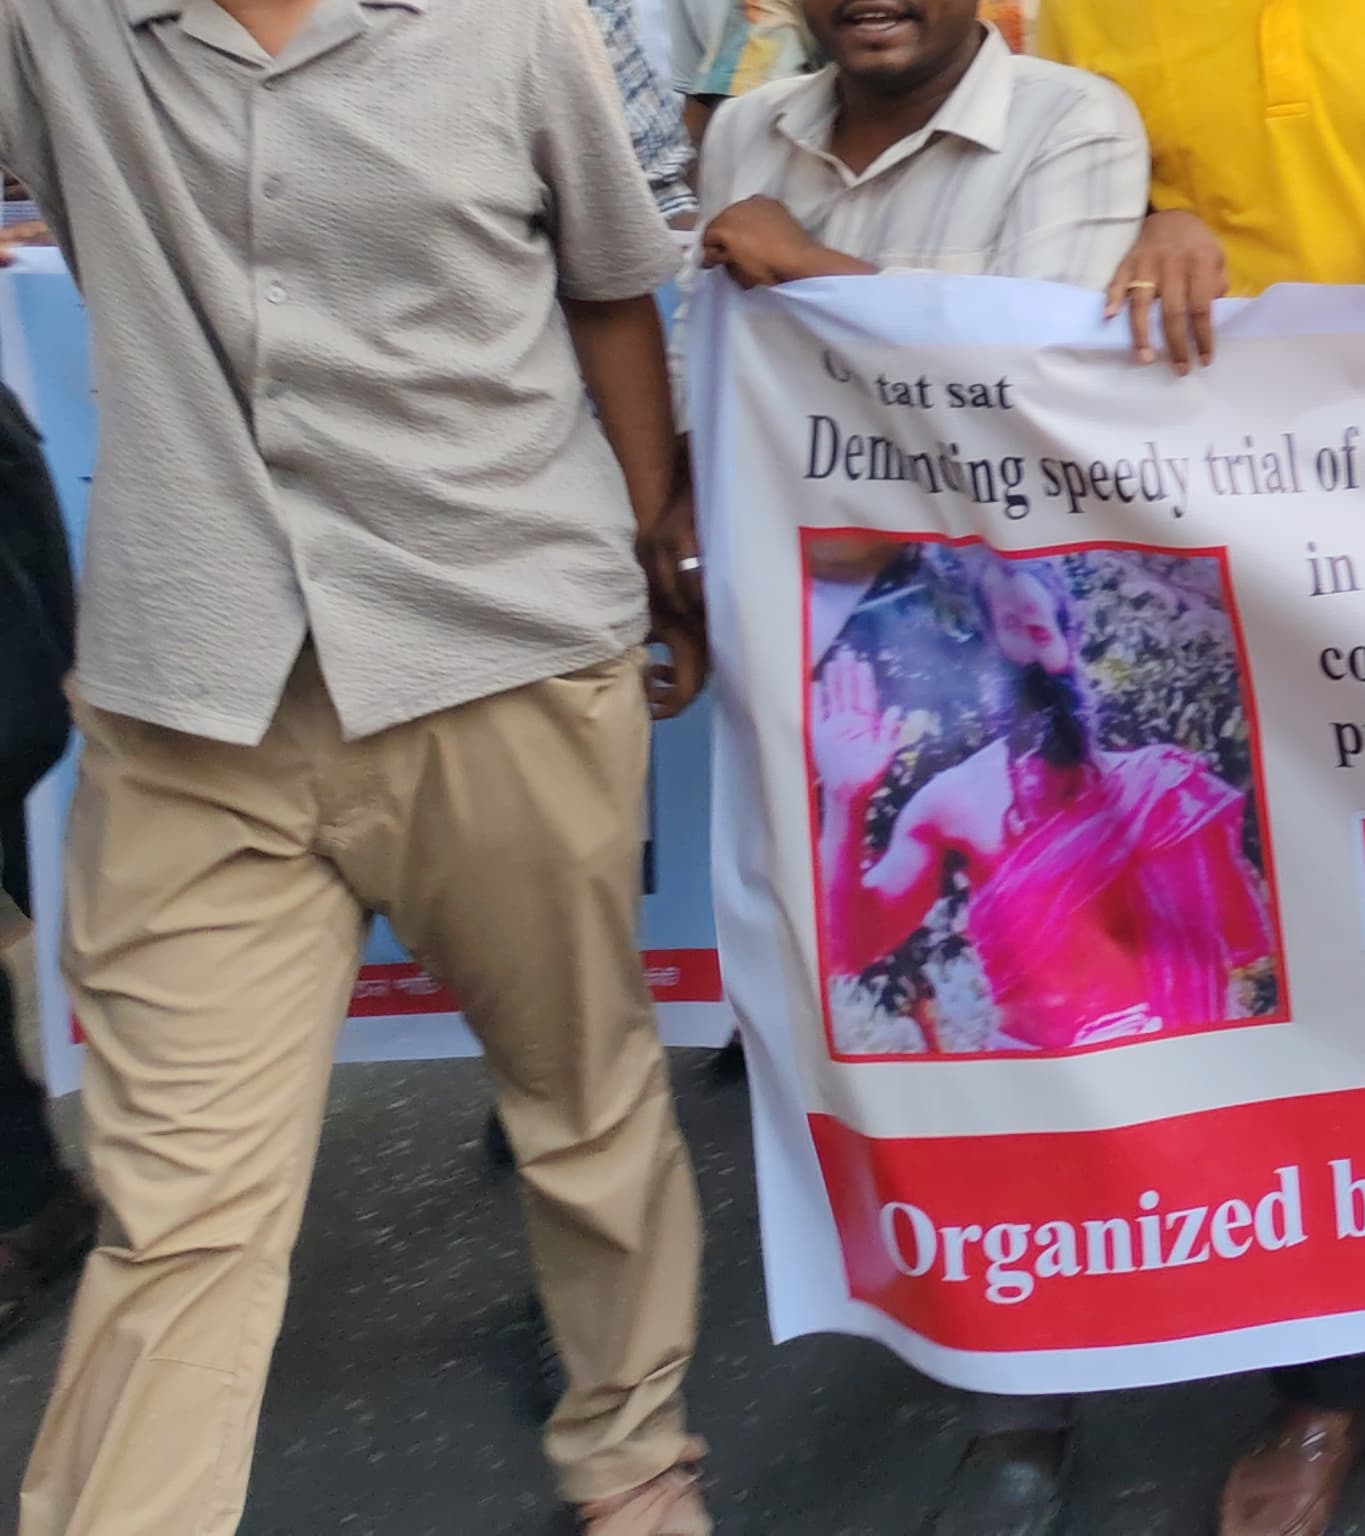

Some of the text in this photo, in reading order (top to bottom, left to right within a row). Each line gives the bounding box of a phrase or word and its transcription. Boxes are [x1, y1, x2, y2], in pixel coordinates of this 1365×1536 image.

[874, 374, 935, 409] tat
[946, 376, 1013, 409] sat
[1042, 441, 1188, 518] speedy
[1204, 432, 1303, 496] trial
[1316, 427, 1360, 492] of
[1306, 542, 1360, 598] in
[878, 1163, 1304, 1306] Organized
